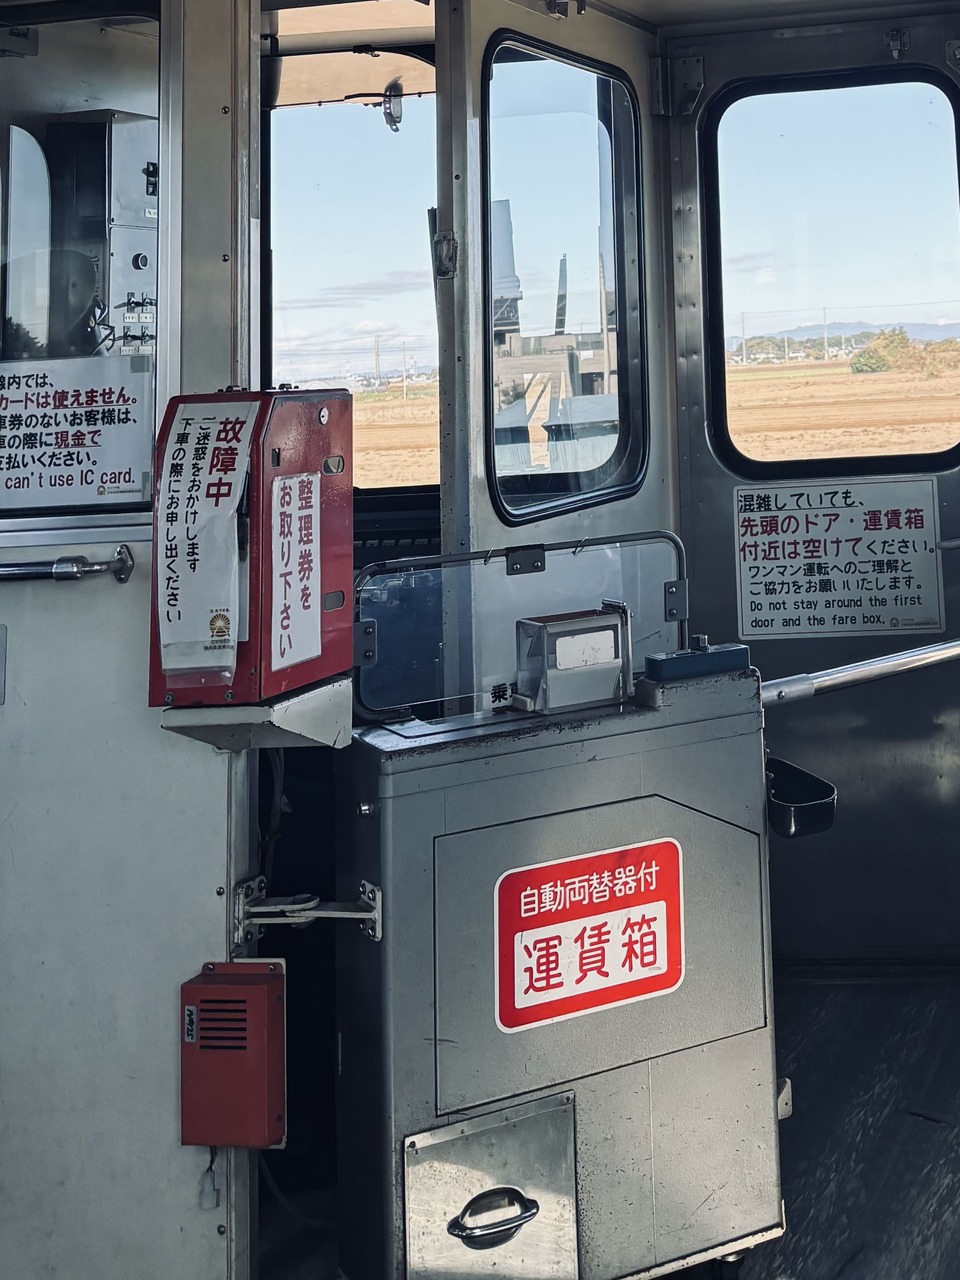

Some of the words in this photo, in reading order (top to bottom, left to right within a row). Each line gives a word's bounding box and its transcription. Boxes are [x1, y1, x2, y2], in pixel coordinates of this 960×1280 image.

[0, 387, 137, 410] カードは使えません。
[0, 451, 97, 471] 払いください。
[205, 417, 246, 507] 故障中
[50, 475, 74, 487] use
[80, 470, 94, 485] IC
[100, 467, 135, 485] card.
[185, 416, 215, 573] ご迷惑をおかけします
[738, 489, 865, 512] 混雑していても、
[165, 417, 195, 622] 下車の際にお申し出ください
[740, 508, 925, 537] 先頭のドア・運賃箱
[298, 478, 313, 611] 整理券を
[740, 536, 935, 562] 付近は空けてください。
[279, 482, 293, 659] お取り下さい
[748, 559, 913, 579] ワンマン運転へのご理解と
[749, 575, 922, 595] ご協力をお願いいたします。
[750, 601, 763, 611] Do
[769, 600, 787, 610] not
[793, 598, 818, 610] stay
[824, 596, 862, 608] around
[868, 595, 887, 606] the
[894, 595, 922, 606] first
[751, 617, 775, 628] door
[782, 615, 800, 627] and
[808, 614, 825, 626] the
[832, 613, 857, 625] fare
[863, 612, 885, 625] box.
[520, 860, 660, 917] 自動両替器付
[523, 914, 658, 995] 運賃箱
